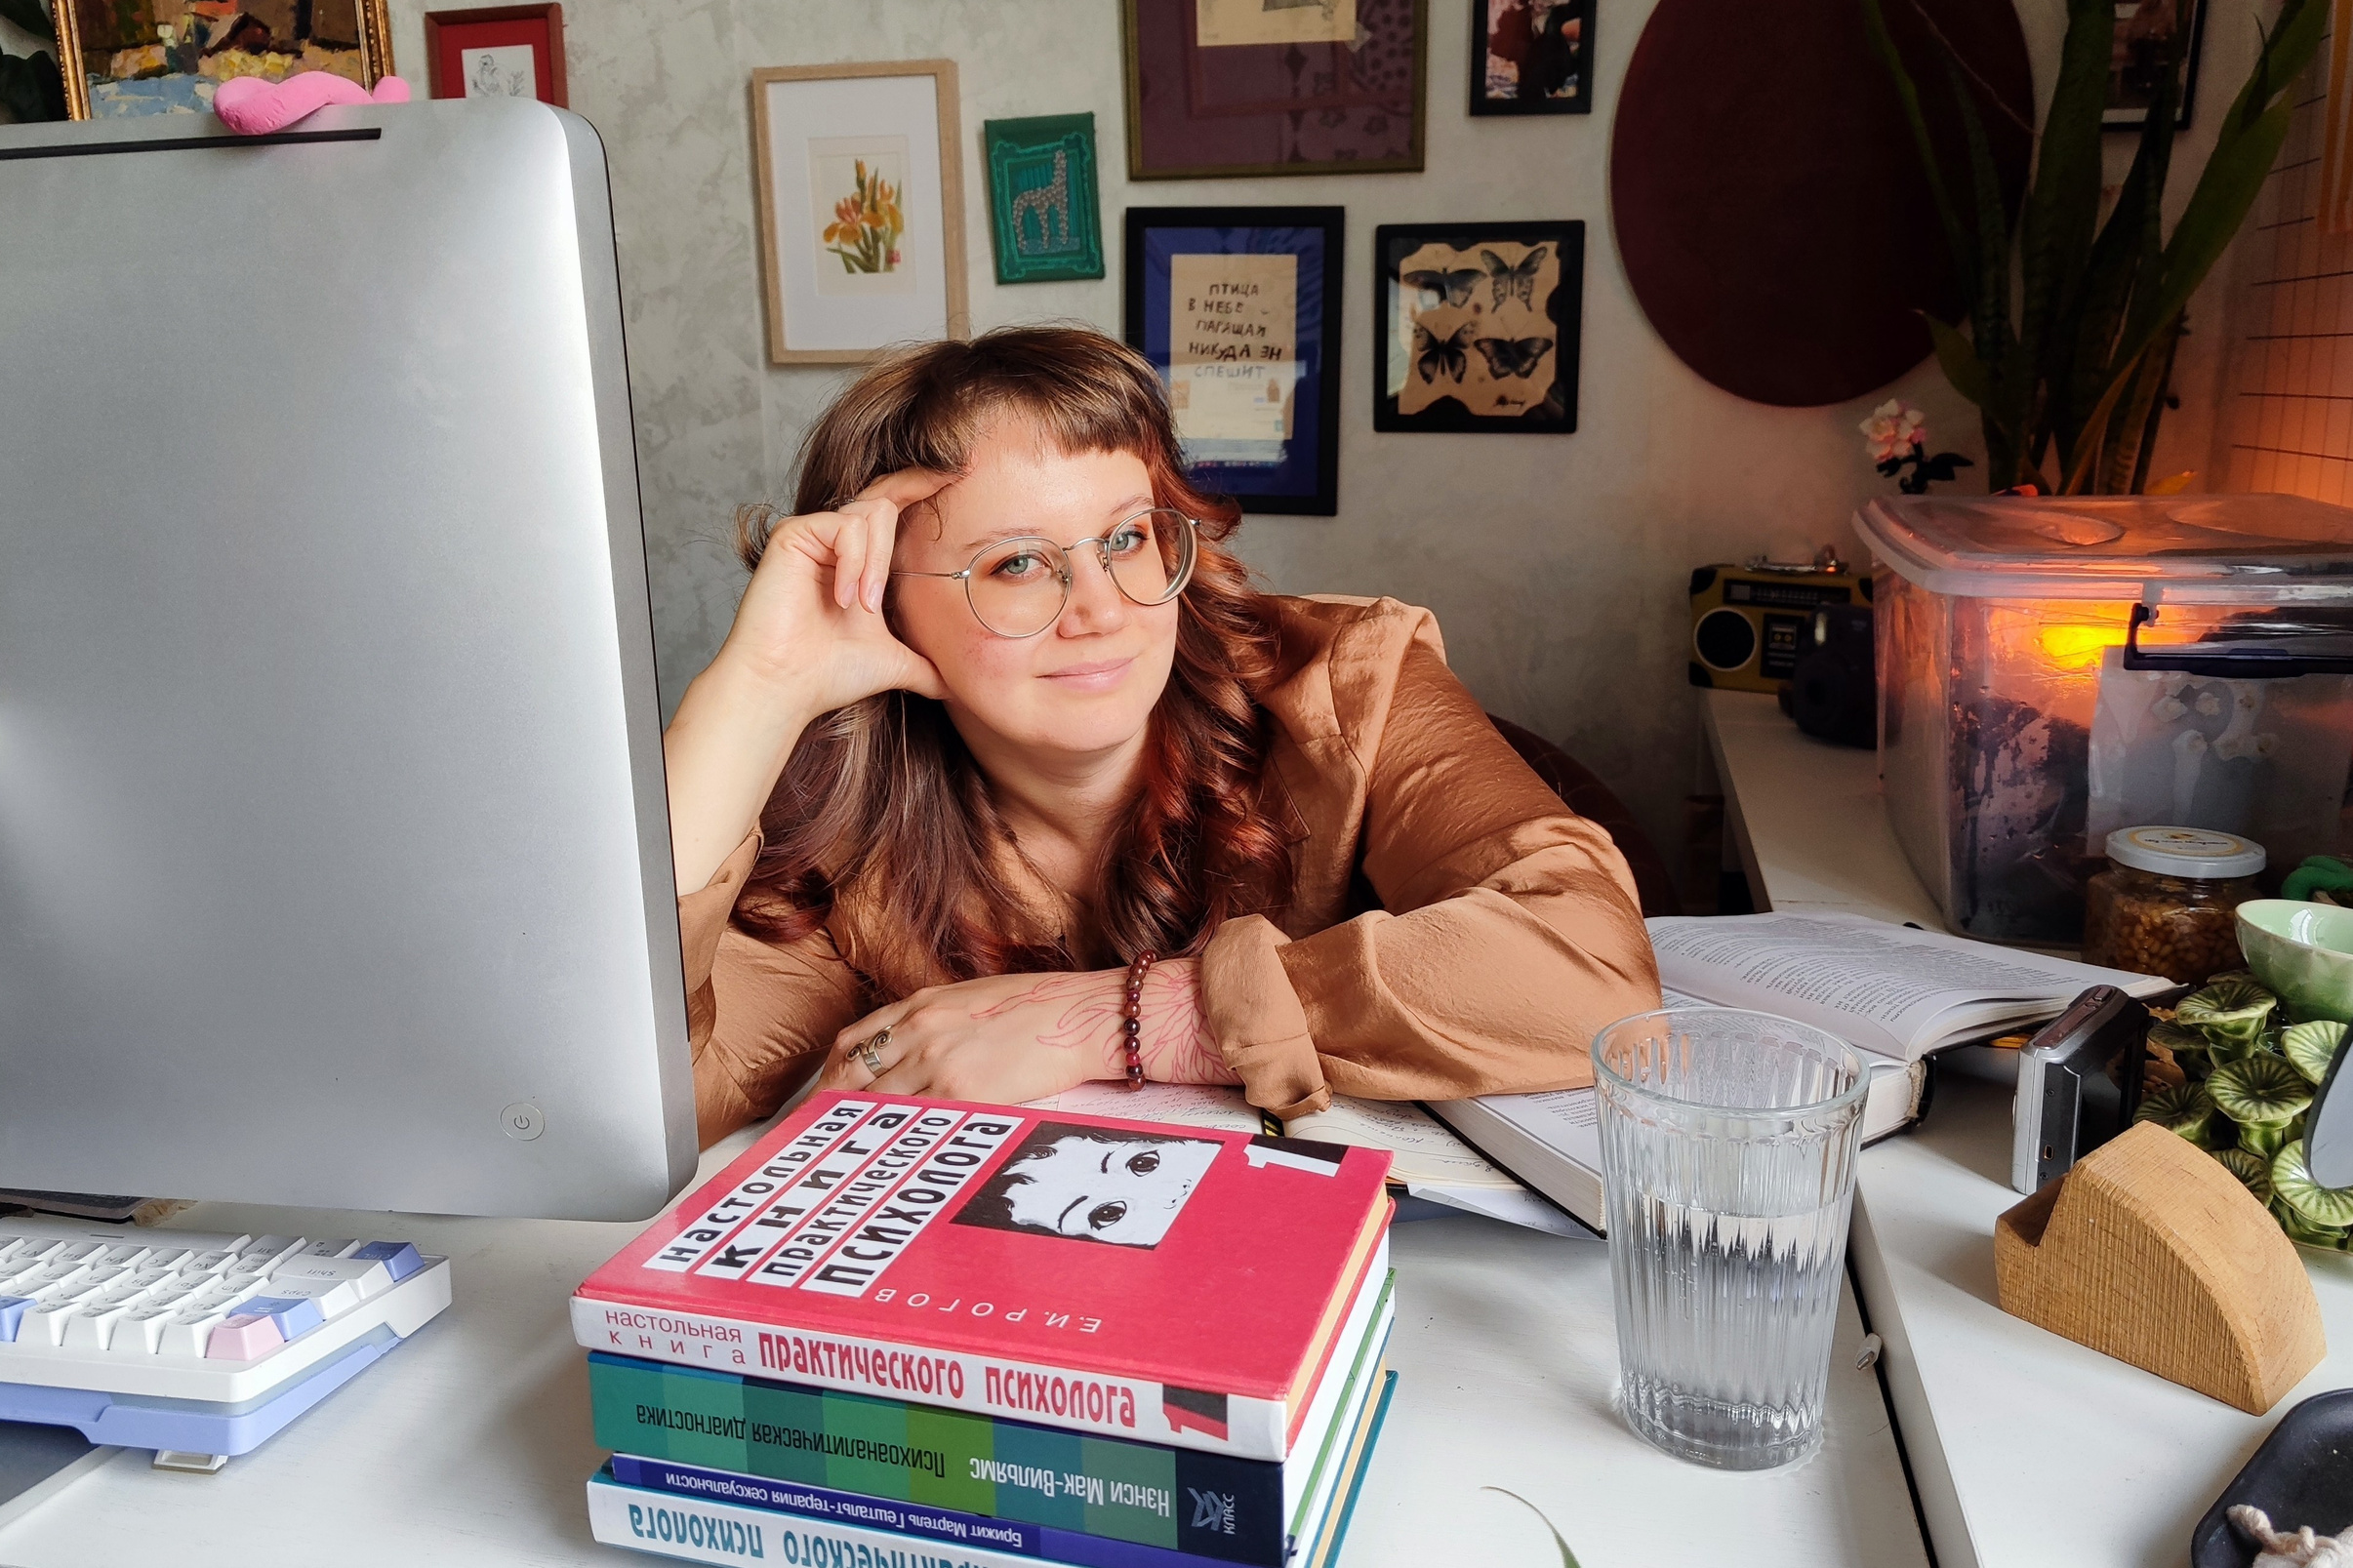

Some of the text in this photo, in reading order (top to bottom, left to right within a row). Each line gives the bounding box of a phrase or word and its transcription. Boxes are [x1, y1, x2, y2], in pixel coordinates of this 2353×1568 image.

[1188, 298, 1244, 314] В НЕБЕ
[1208, 284, 1259, 298] ПТИЦА
[1189, 342, 1251, 362] НИКУДА
[1195, 365, 1266, 379] СПЕШИТ
[659, 1106, 864, 1263] настольная
[711, 1112, 909, 1269] книга
[761, 1116, 952, 1277] практического
[813, 1120, 1010, 1287] психолога
[281, 1289, 312, 1299] Caps
[307, 1268, 337, 1277] Shift
[873, 1287, 1030, 1322] РОГОВ
[605, 1309, 743, 1344] настольная
[609, 1330, 746, 1364] книга
[757, 1332, 1136, 1428] практического психолога
[636, 1403, 946, 1478] Психоаналитическая диагностика
[969, 1457, 1171, 1517] Нэнси Мак-Вильямс
[629, 1503, 764, 1560] психолога
[666, 1472, 1023, 1548] Брижит Мартель Гештальт-терапия сексуальности
[1223, 1493, 1236, 1536] КЛАСС
